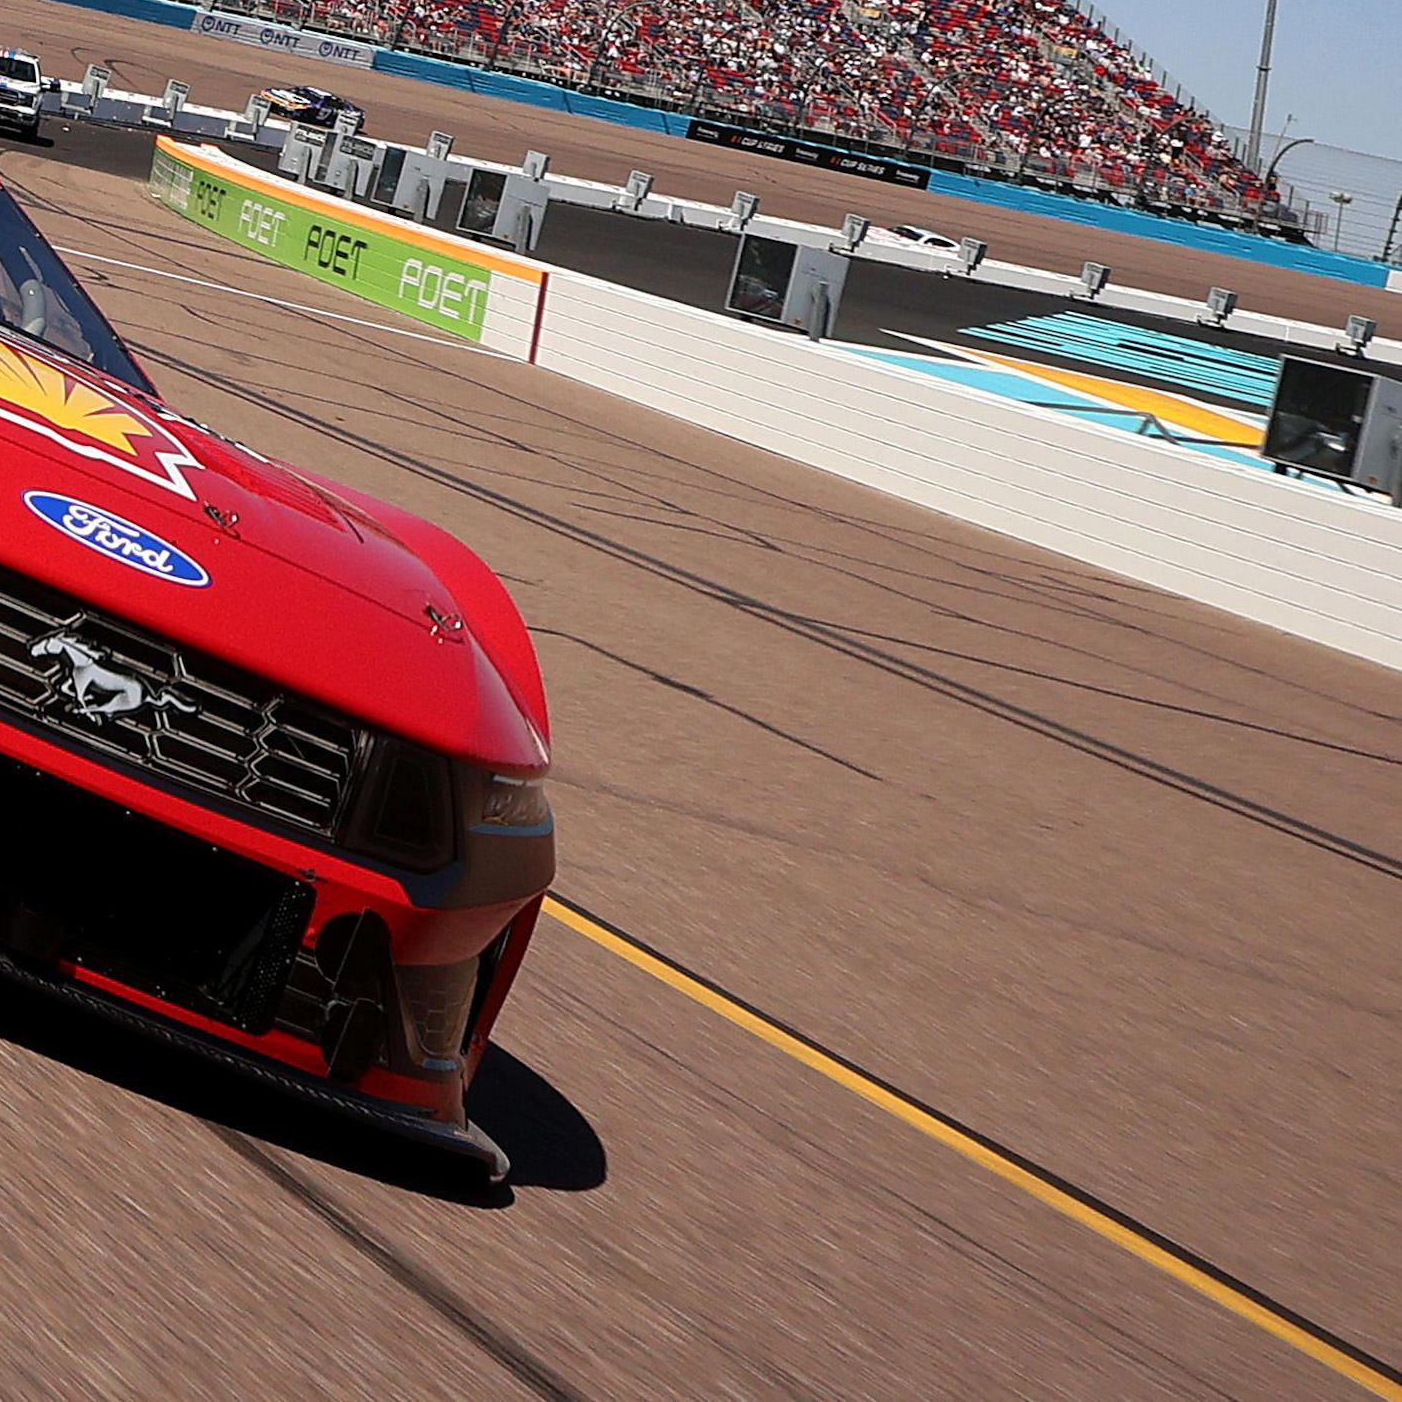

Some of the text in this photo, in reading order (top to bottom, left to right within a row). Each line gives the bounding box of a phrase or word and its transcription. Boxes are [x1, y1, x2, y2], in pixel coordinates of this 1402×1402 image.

[197, 181, 227, 223] POET
[237, 199, 286, 248] POET
[304, 225, 368, 280] POET
[399, 257, 487, 325] POET
[62, 505, 174, 572] Ford
